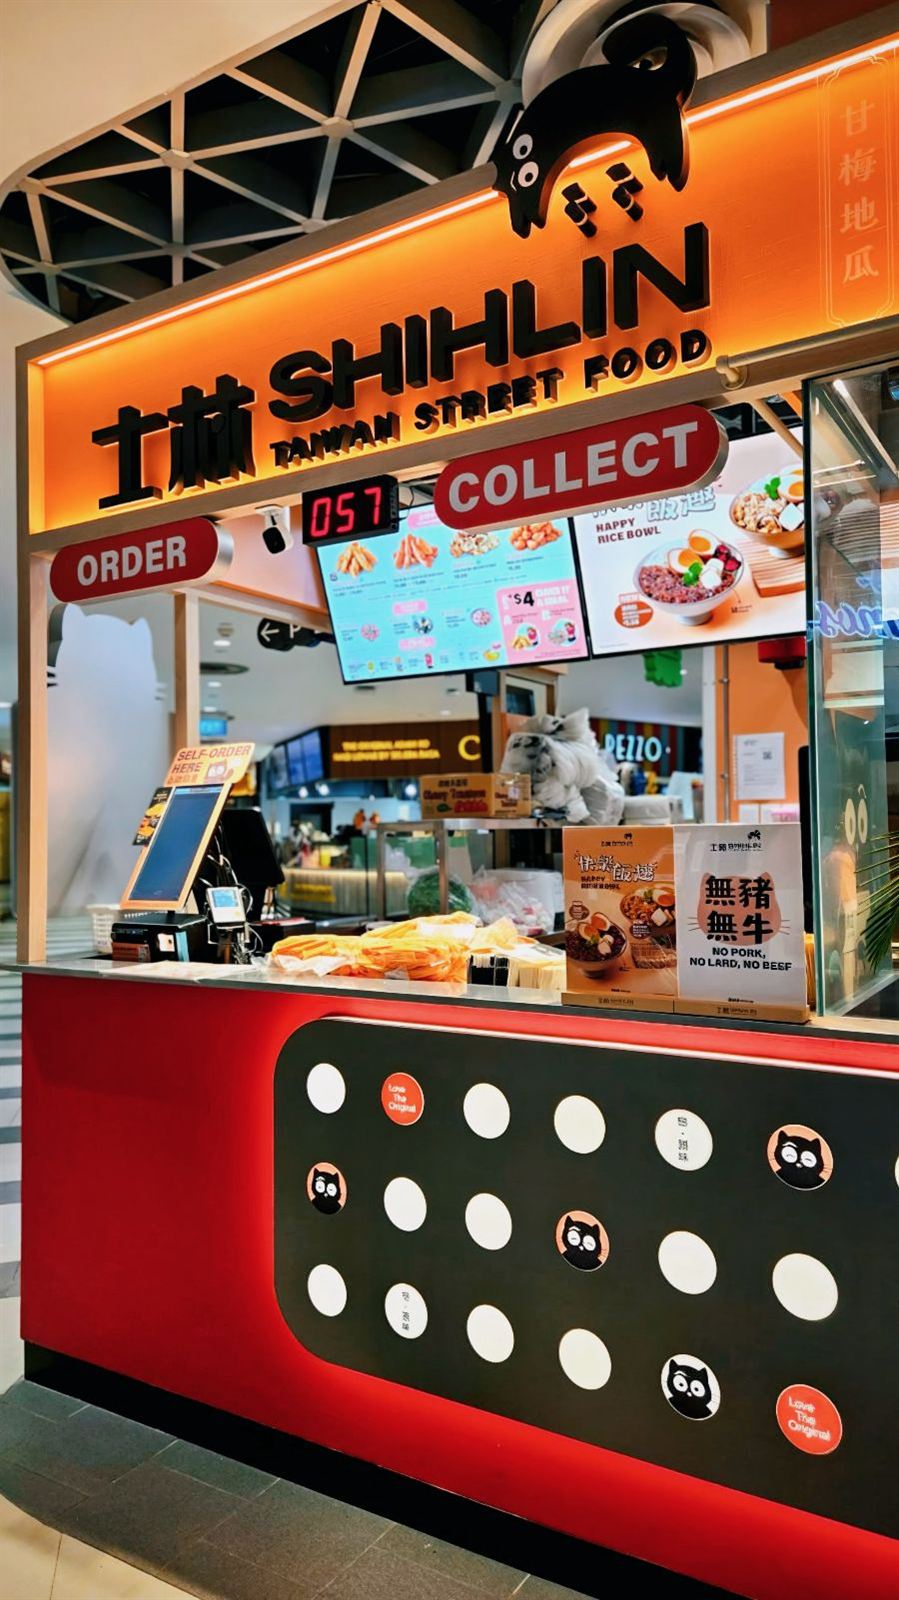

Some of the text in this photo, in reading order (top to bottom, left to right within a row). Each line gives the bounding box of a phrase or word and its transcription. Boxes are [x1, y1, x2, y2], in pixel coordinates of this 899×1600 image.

[839, 98, 879, 284] 甘梅地瓜
[269, 222, 711, 423] SHIHLIN
[270, 329, 712, 468] TAIWAN STREET FOOD
[449, 421, 698, 513] COLLECT
[310, 486, 381, 537] 057
[596, 518, 635, 532] HAPPY
[598, 526, 661, 544] RICE BOWL
[77, 535, 187, 586] ORDER
[177, 745, 252, 761] SELF-ORDER
[604, 734, 662, 762] PEZZO
[171, 762, 204, 774] HERE
[705, 875, 773, 910] 無豬
[707, 911, 774, 944] 無牛
[690, 957, 792, 971] NO LARD, NO BEEF
[712, 947, 766, 959] NO PORK,
[789, 1395, 815, 1413] Love
[795, 1409, 816, 1425] The
[788, 1419, 831, 1441] Original
